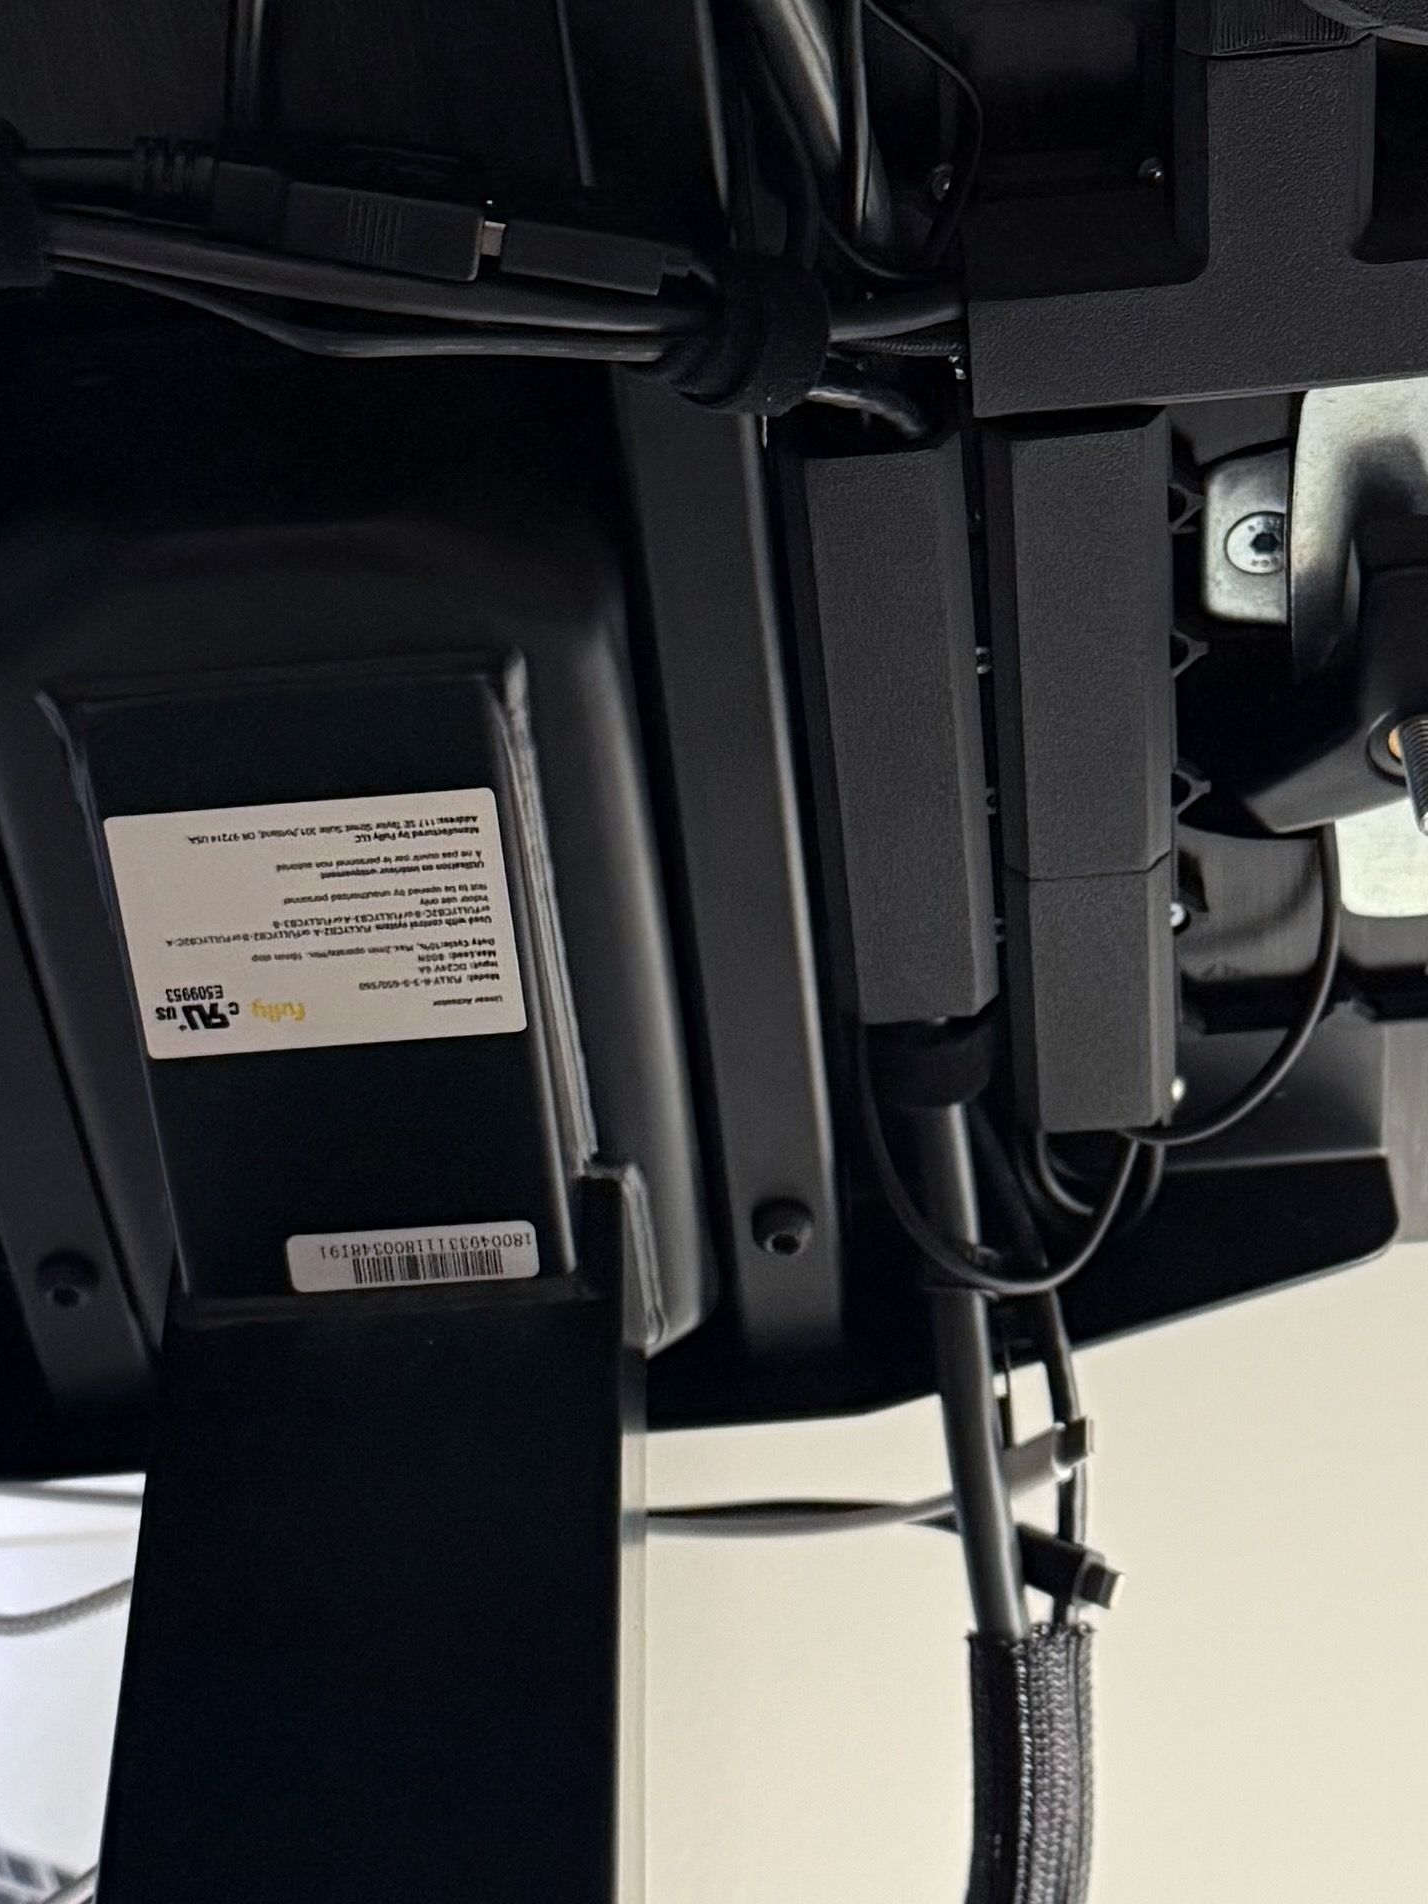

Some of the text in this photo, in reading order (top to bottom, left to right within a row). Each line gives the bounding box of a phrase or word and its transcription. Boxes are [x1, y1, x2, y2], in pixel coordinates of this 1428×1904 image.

[354, 826, 479, 842] Manufactured by Fully LLC
[419, 897, 438, 905] only
[409, 919, 442, 929] control
[444, 917, 466, 926] with
[468, 915, 491, 924] Used
[375, 920, 407, 930] system
[471, 936, 494, 946] Duty
[165, 984, 223, 1002] E509953
